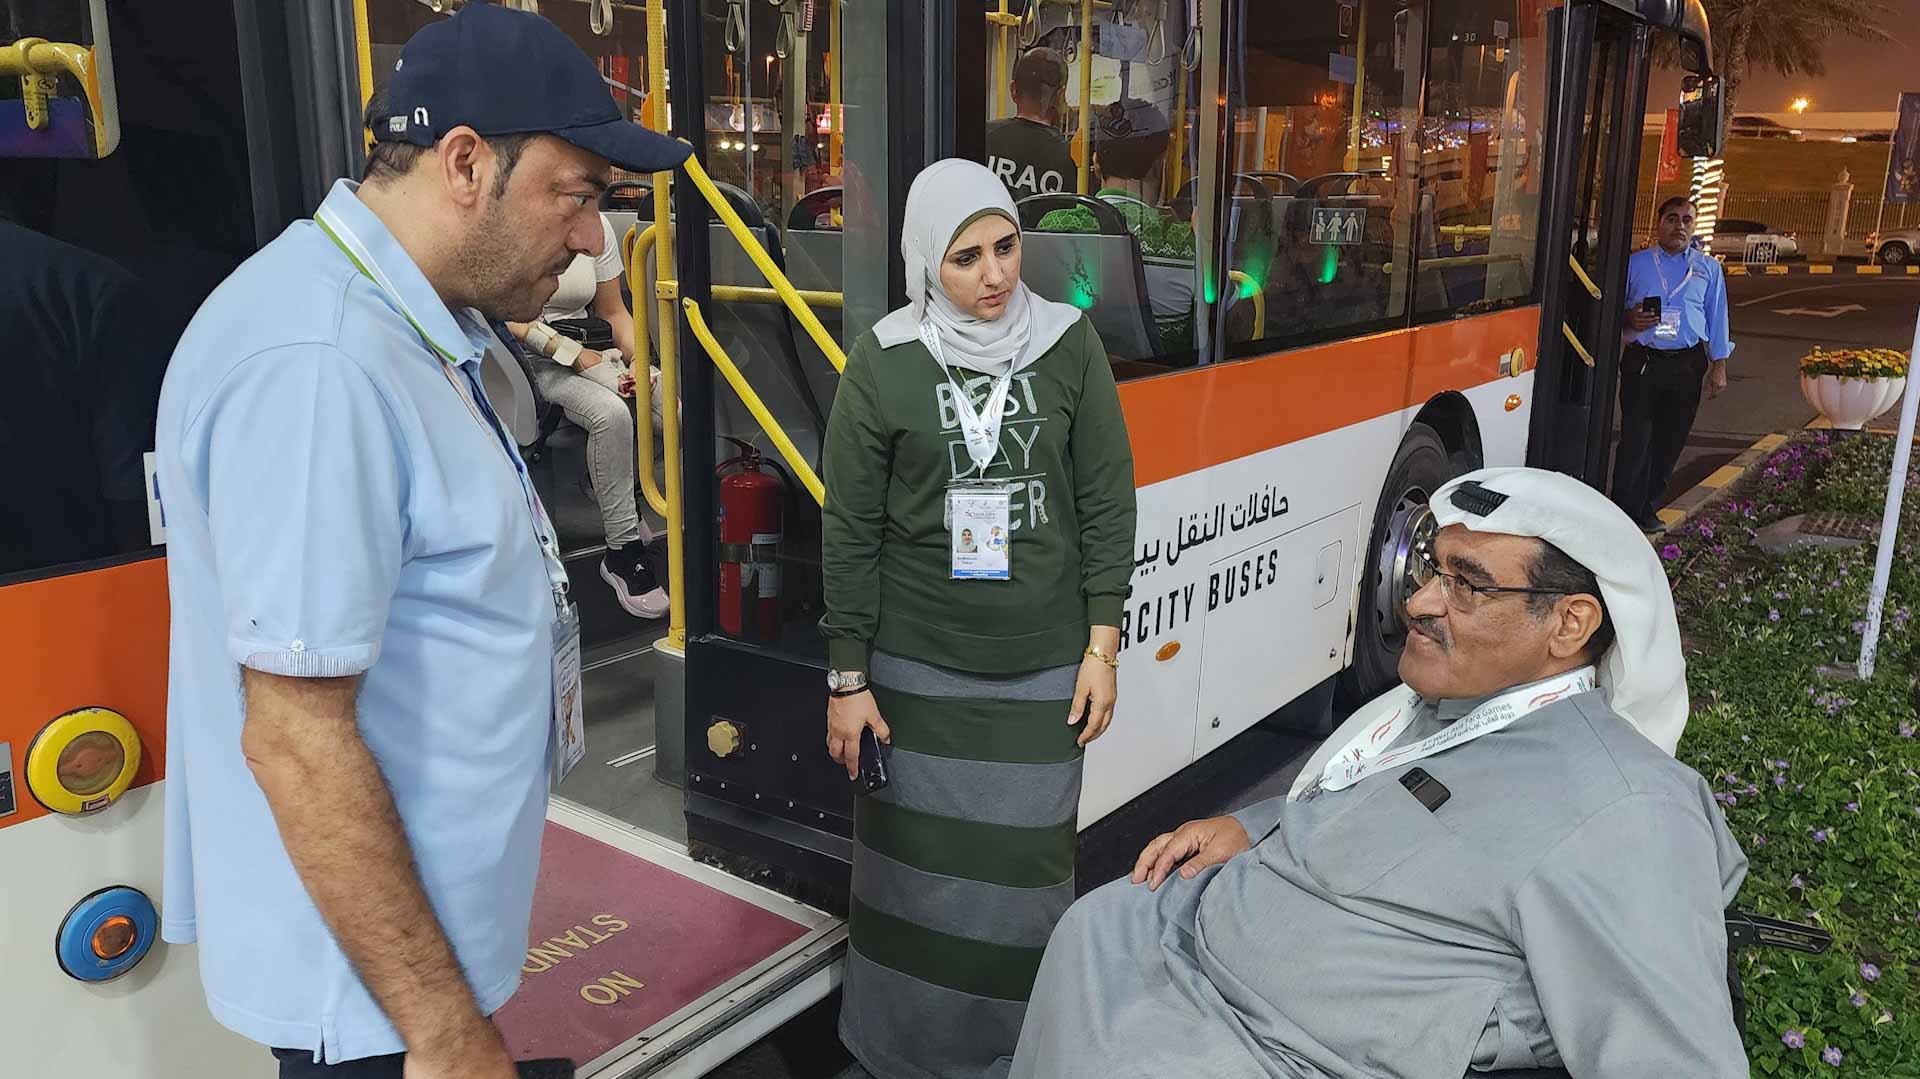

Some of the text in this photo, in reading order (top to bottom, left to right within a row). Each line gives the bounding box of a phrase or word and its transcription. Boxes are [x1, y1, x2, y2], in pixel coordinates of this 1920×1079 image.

[987, 155, 1063, 194] IRAQ
[944, 480, 1049, 531] ER
[1130, 484, 1289, 586] حافلات النقل بي
[1208, 549, 1278, 612] BUSES
[1482, 702, 1512, 718] Games
[580, 970, 645, 1005] NO
